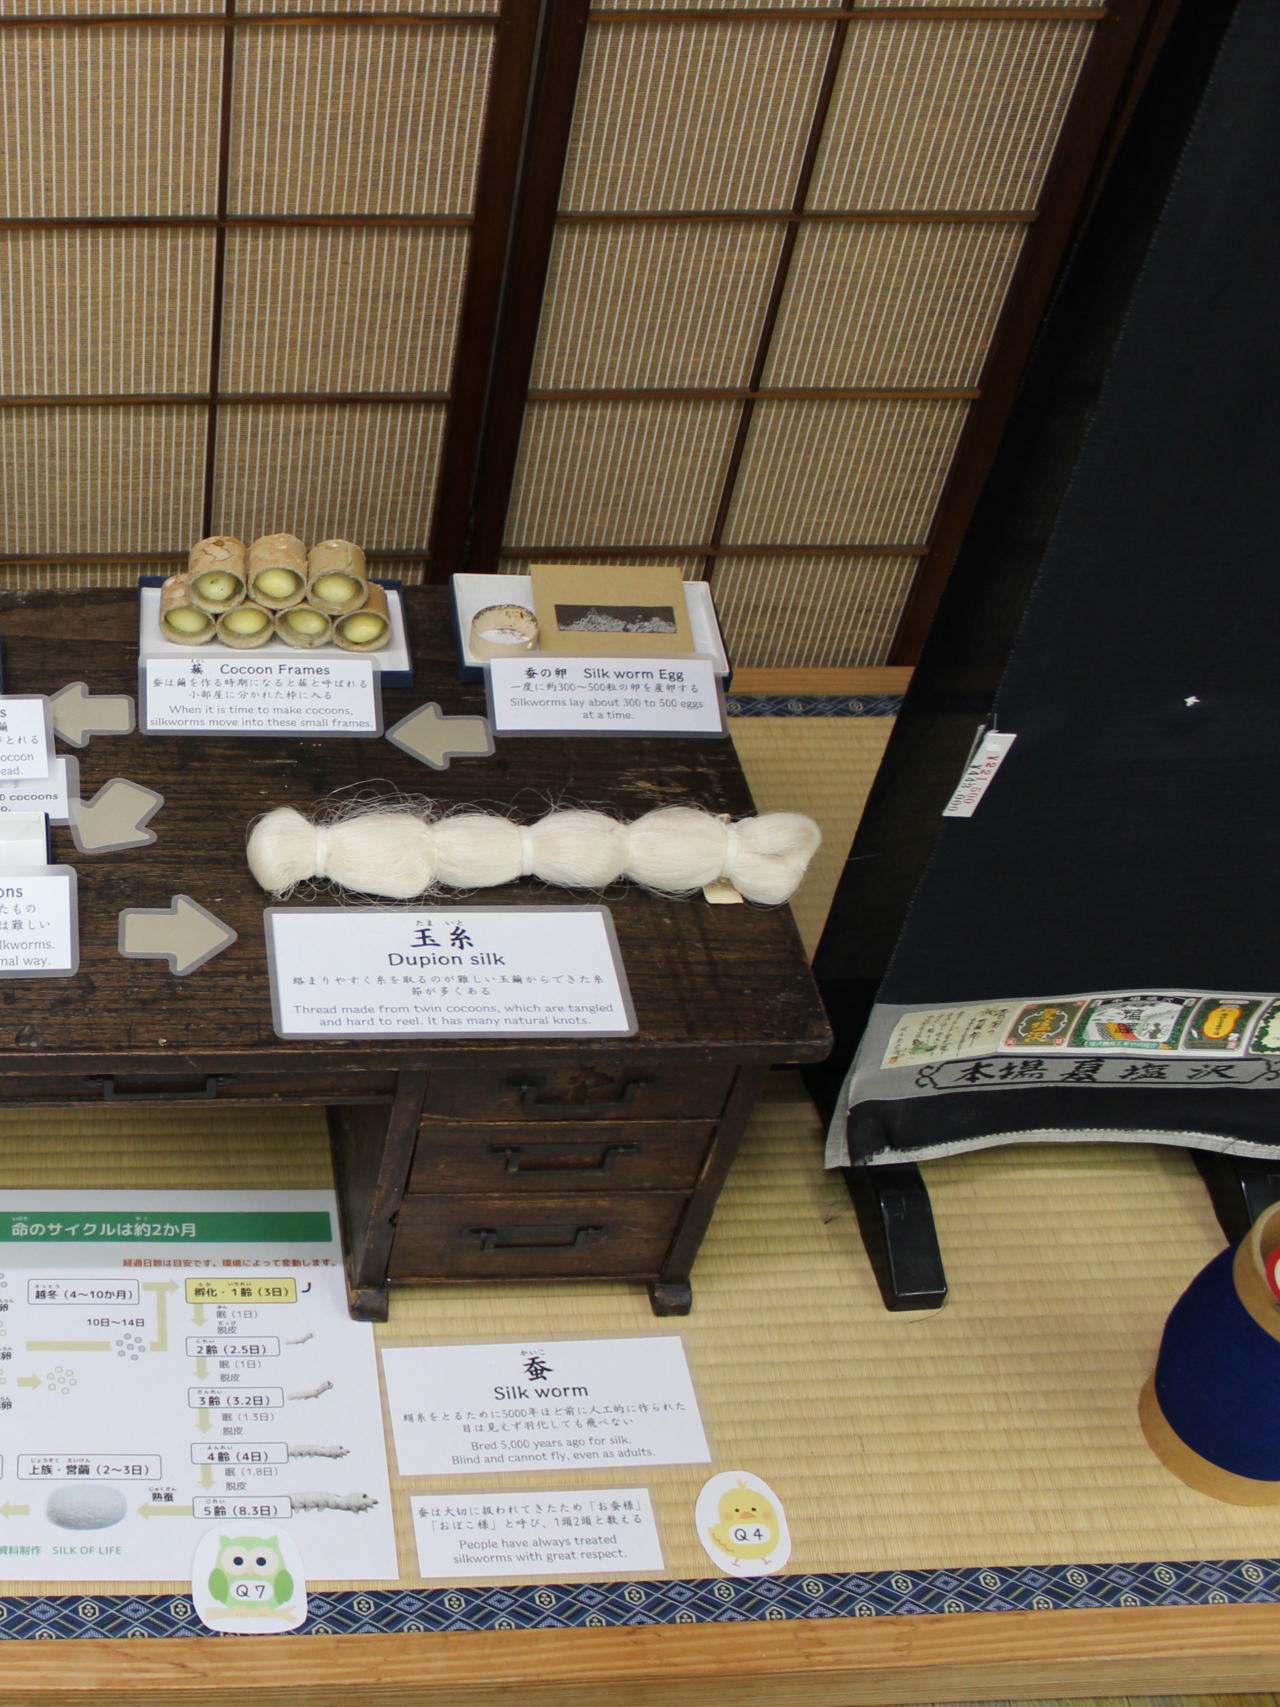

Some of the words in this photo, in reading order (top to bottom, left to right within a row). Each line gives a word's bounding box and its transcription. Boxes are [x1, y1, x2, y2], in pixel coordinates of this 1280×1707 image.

[220, 664, 273, 675] Cocoon
[278, 664, 330, 675] Frames
[525, 667, 567, 679] 蚕の卵
[583, 668, 610, 679] Silk
[613, 671, 654, 679] worm
[658, 669, 684, 682] Egg
[169, 705, 202, 714] When
[205, 705, 214, 714] it
[217, 705, 226, 714] is
[229, 705, 254, 714] time
[257, 706, 270, 714] to
[273, 706, 302, 715] make
[305, 707, 353, 716] cocoons,
[510, 698, 567, 707] Silkworms
[569, 698, 585, 708] lay
[588, 698, 620, 707] about
[623, 698, 642, 707] 300
[644, 699, 657, 708] to
[659, 698, 678, 708] 500
[680, 701, 704, 710] eggs
[410, 927, 474, 950] 玉糸
[388, 952, 463, 968] Dupion
[470, 952, 506, 965] silk
[292, 1005, 337, 1014] Thread
[341, 1005, 375, 1014] made
[378, 1004, 410, 1013] from
[413, 1004, 442, 1013] twin
[446, 1005, 501, 1013] cocoons,
[503, 1004, 541, 1013] which
[567, 1003, 614, 1014] tangled
[954, 1058, 1240, 1083] 本場夏塩沢
[11, 1222, 197, 1237] 命のサイクルは約2か月
[522, 1356, 554, 1382] 蚕
[494, 1386, 530, 1400] Silk
[534, 1386, 589, 1398] worm
[470, 1441, 497, 1451] Bred
[500, 1439, 530, 1450] 5,000
[532, 1440, 563, 1450] years
[566, 1439, 586, 1449] ago
[588, 1436, 606, 1446] for
[609, 1435, 632, 1445] silk.
[459, 1539, 498, 1549] People
[501, 1538, 529, 1548] have
[532, 1537, 571, 1548] always
[574, 1534, 617, 1546] treated
[52, 1545, 77, 1556] SILK
[79, 1546, 96, 1556] OF
[98, 1546, 122, 1556] LIFE
[453, 1554, 513, 1564] silkworms
[515, 1551, 543, 1562] with
[546, 1551, 577, 1563] great
[580, 1549, 627, 1561] respect.
